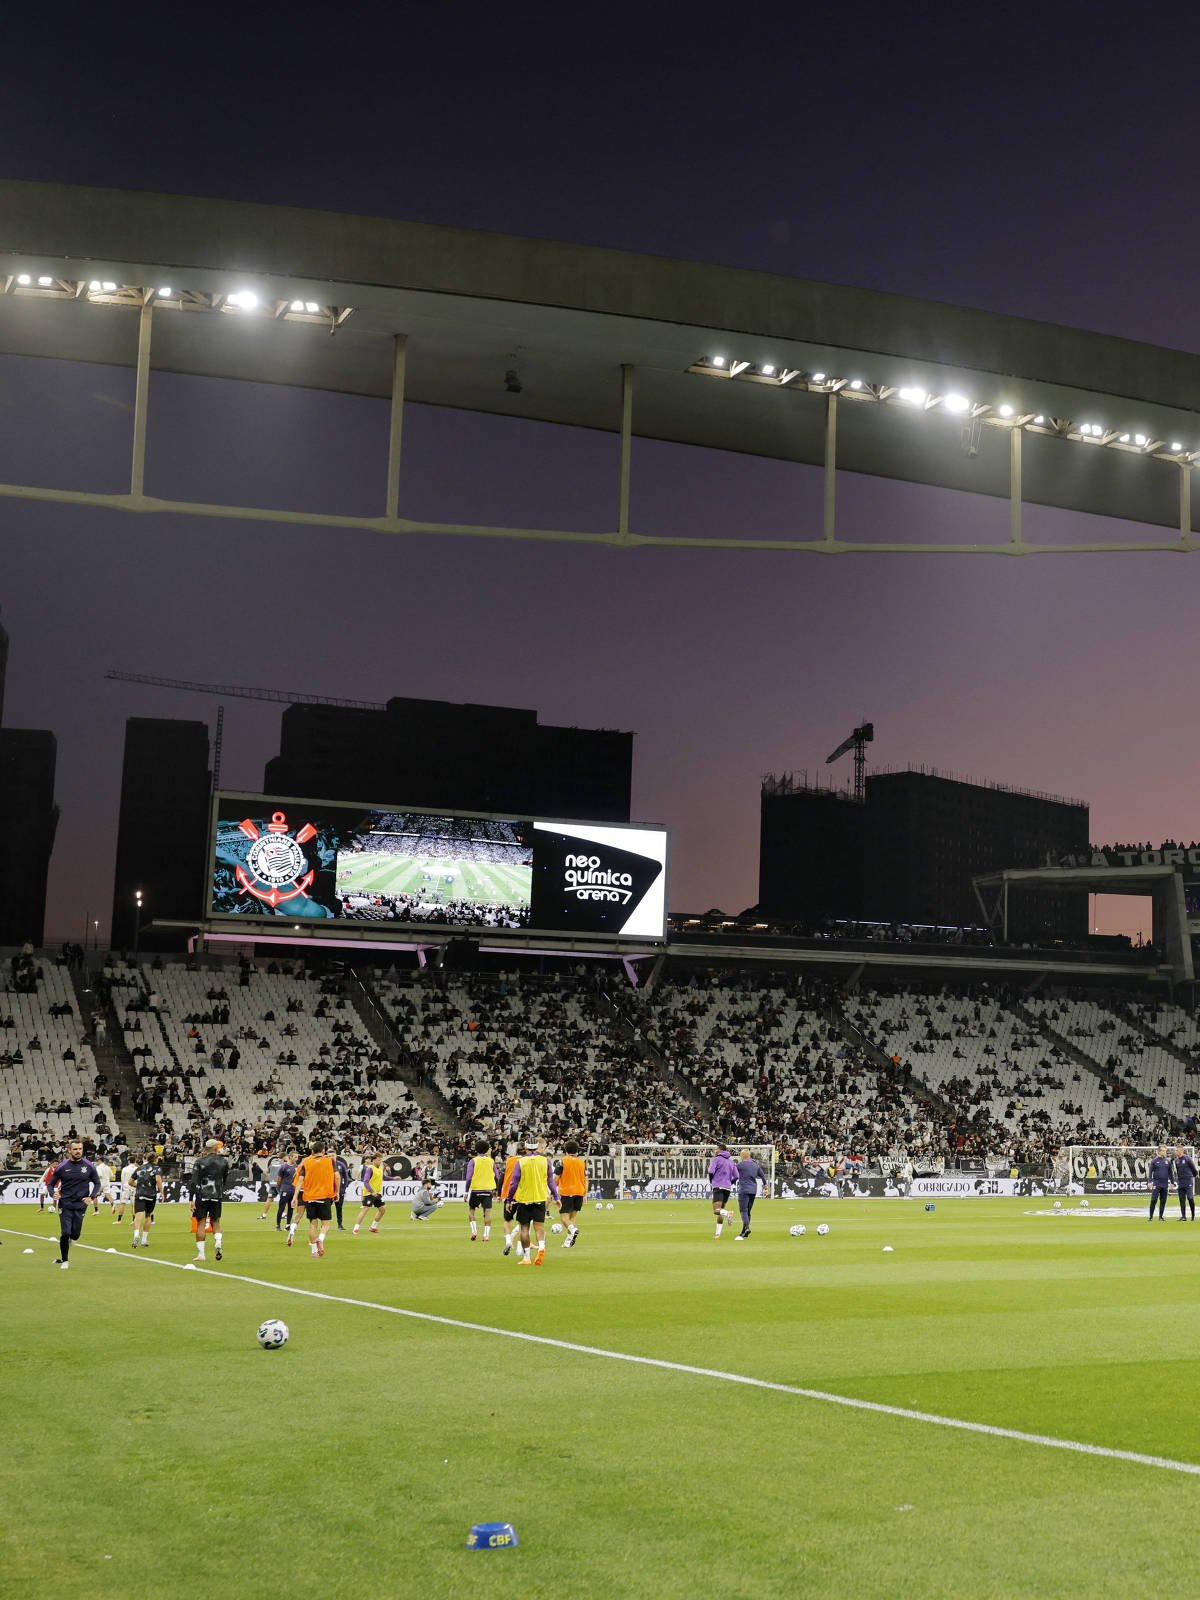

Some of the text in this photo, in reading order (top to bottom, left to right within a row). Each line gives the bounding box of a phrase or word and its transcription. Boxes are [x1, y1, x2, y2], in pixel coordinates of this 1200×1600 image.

[565, 854, 601, 869] neo
[1091, 852, 1110, 868] A
[564, 867, 633, 888] química
[576, 889, 620, 902] arena
[631, 1158, 713, 1179] DETERMINA
[918, 1182, 970, 1192] OBRIGADO
[1096, 1180, 1148, 1192] Esportes
[488, 1534, 511, 1547] CBF
